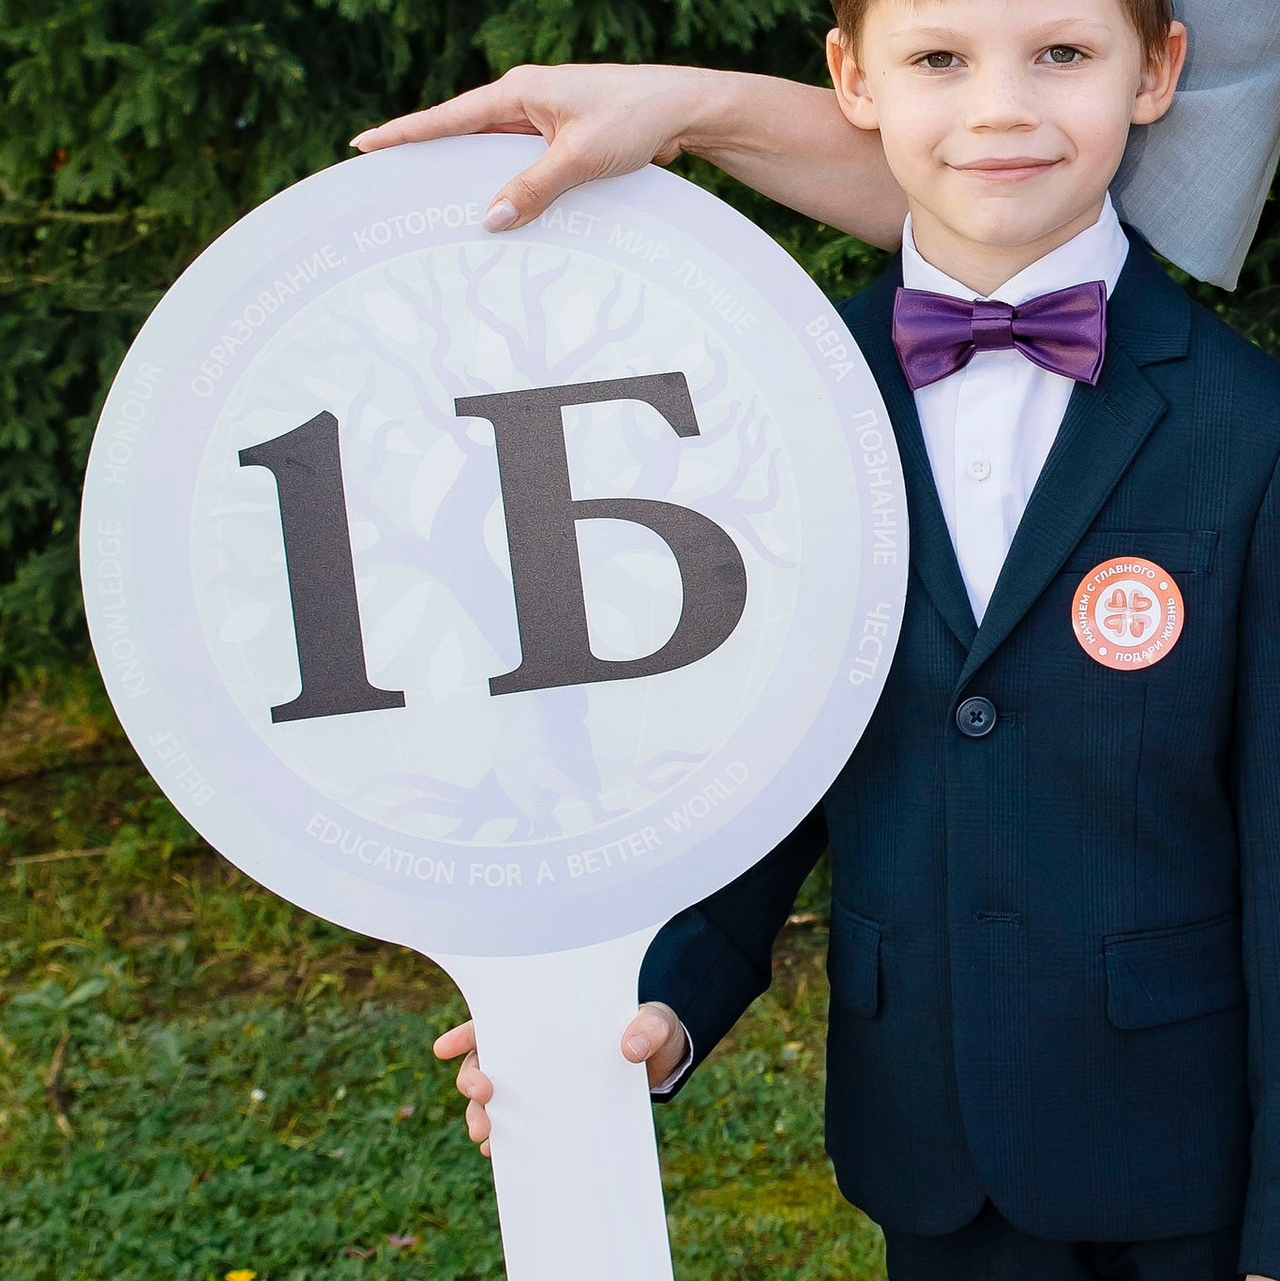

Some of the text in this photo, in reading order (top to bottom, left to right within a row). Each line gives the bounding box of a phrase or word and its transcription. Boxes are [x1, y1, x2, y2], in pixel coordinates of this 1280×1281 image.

[190, 243, 349, 398] ОБРАЗОВАНИЕ,
[352, 202, 481, 253] КОТОРОЕ
[607, 225, 671, 265] МИР
[671, 260, 757, 337] ЛУЧШЕ
[95, 360, 216, 809] BELIEF KNOWLEDGE HONOUR
[237, 371, 748, 725] 1Б
[804, 314, 898, 687] ВЕРА ПОЗНАНИЕ ЧЕСТЬ
[1078, 564, 1156, 645] НАЧНЕМ С ГЛАВНОГО
[1115, 597, 1176, 663] ПОДАРИ ЖИЗНЬ
[304, 760, 750, 889] EDUCATION FOR A BETTER WORLD
